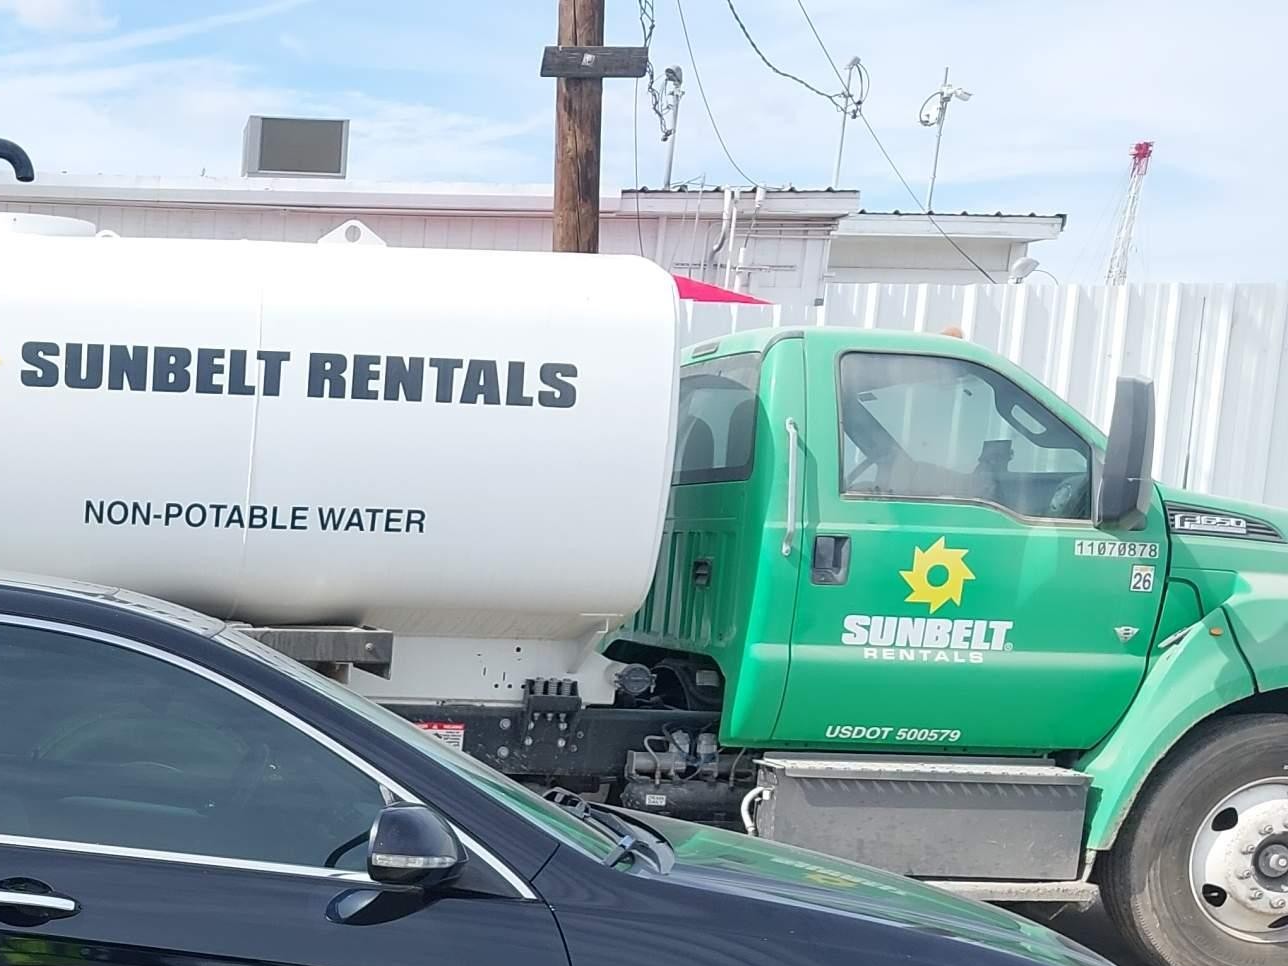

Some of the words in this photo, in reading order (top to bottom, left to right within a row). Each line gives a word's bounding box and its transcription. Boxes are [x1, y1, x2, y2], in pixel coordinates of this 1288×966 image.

[20, 341, 290, 397] SUNBELT
[307, 352, 578, 408] RENTALS
[84, 500, 309, 530] NON-POTABLE
[318, 507, 426, 534] WATER
[1076, 541, 1159, 558] 11070878
[1132, 572, 1152, 590] 26
[842, 614, 1013, 651] SUNBELT
[863, 647, 984, 664] RENTALS
[825, 725, 894, 740] USDOT
[895, 728, 961, 743] 500579
